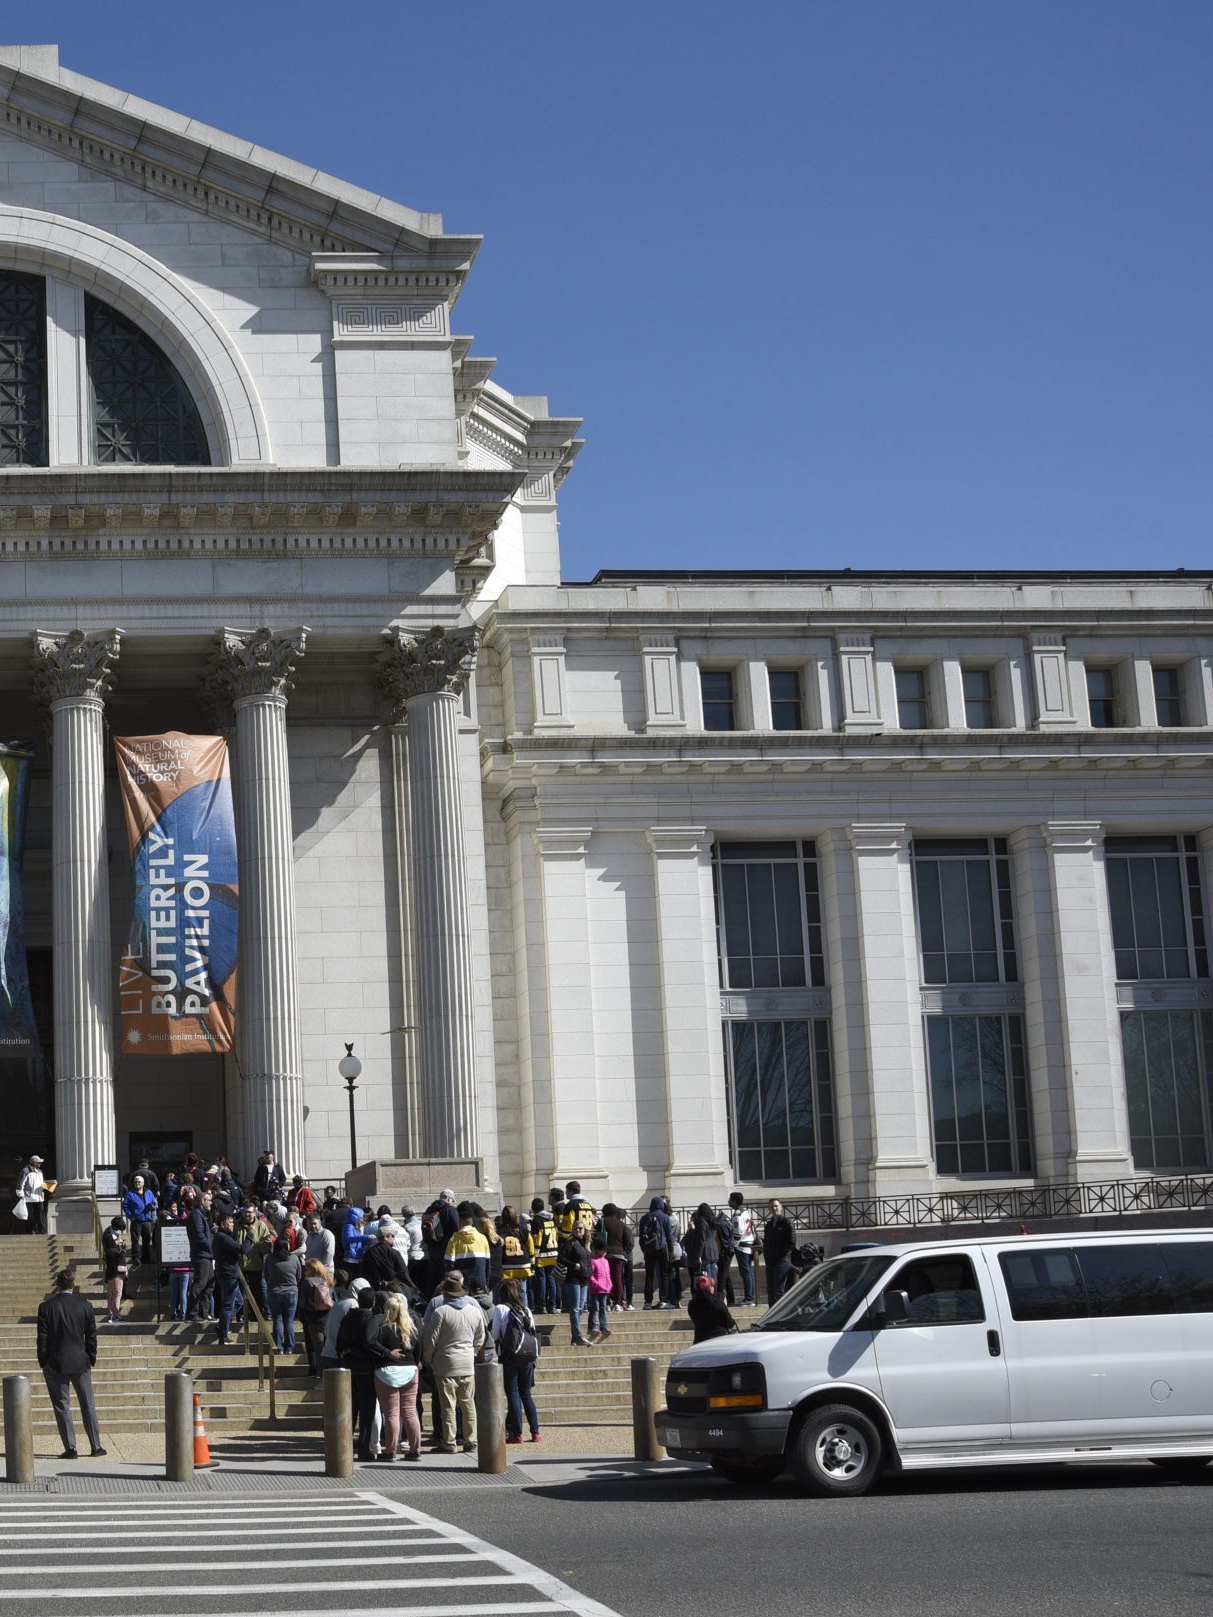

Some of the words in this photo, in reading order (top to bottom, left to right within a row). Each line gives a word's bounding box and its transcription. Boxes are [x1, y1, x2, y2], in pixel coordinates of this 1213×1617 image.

[125, 739, 188, 754] NATIONAL
[125, 750, 179, 764] MUSEUM
[180, 750, 191, 762] of
[127, 760, 185, 774] NATURAL
[127, 771, 180, 785] HISTORY
[148, 831, 178, 1015] BUTTERFLY
[183, 853, 210, 1014] PAVILION
[119, 941, 143, 1015] LIVE
[147, 1032, 193, 1041] Smithsonian
[708, 1429, 724, 1437] 4494
